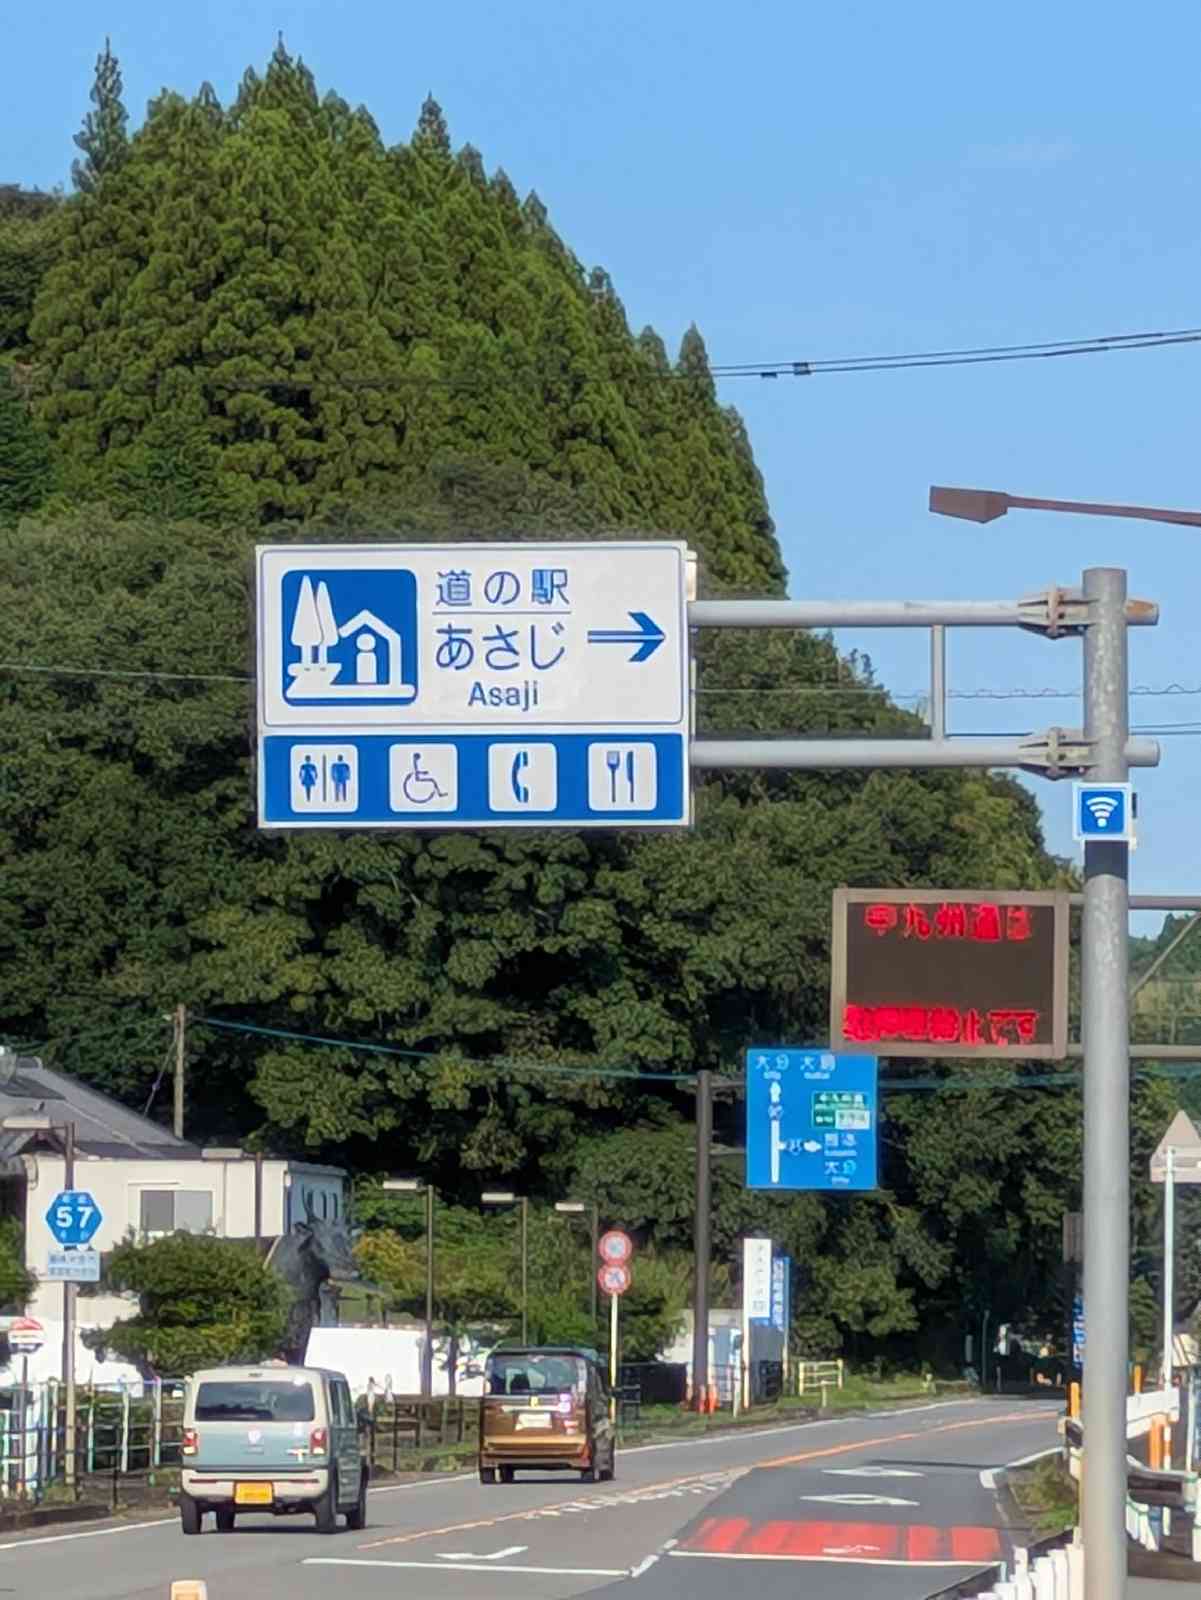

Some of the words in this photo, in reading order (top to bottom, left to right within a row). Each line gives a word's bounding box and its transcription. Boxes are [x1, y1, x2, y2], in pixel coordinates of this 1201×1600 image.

[436, 569, 570, 607] 道の駅
[435, 622, 565, 671] あさじ
[468, 680, 538, 712] Asaji
[56, 1206, 94, 1229] 57
